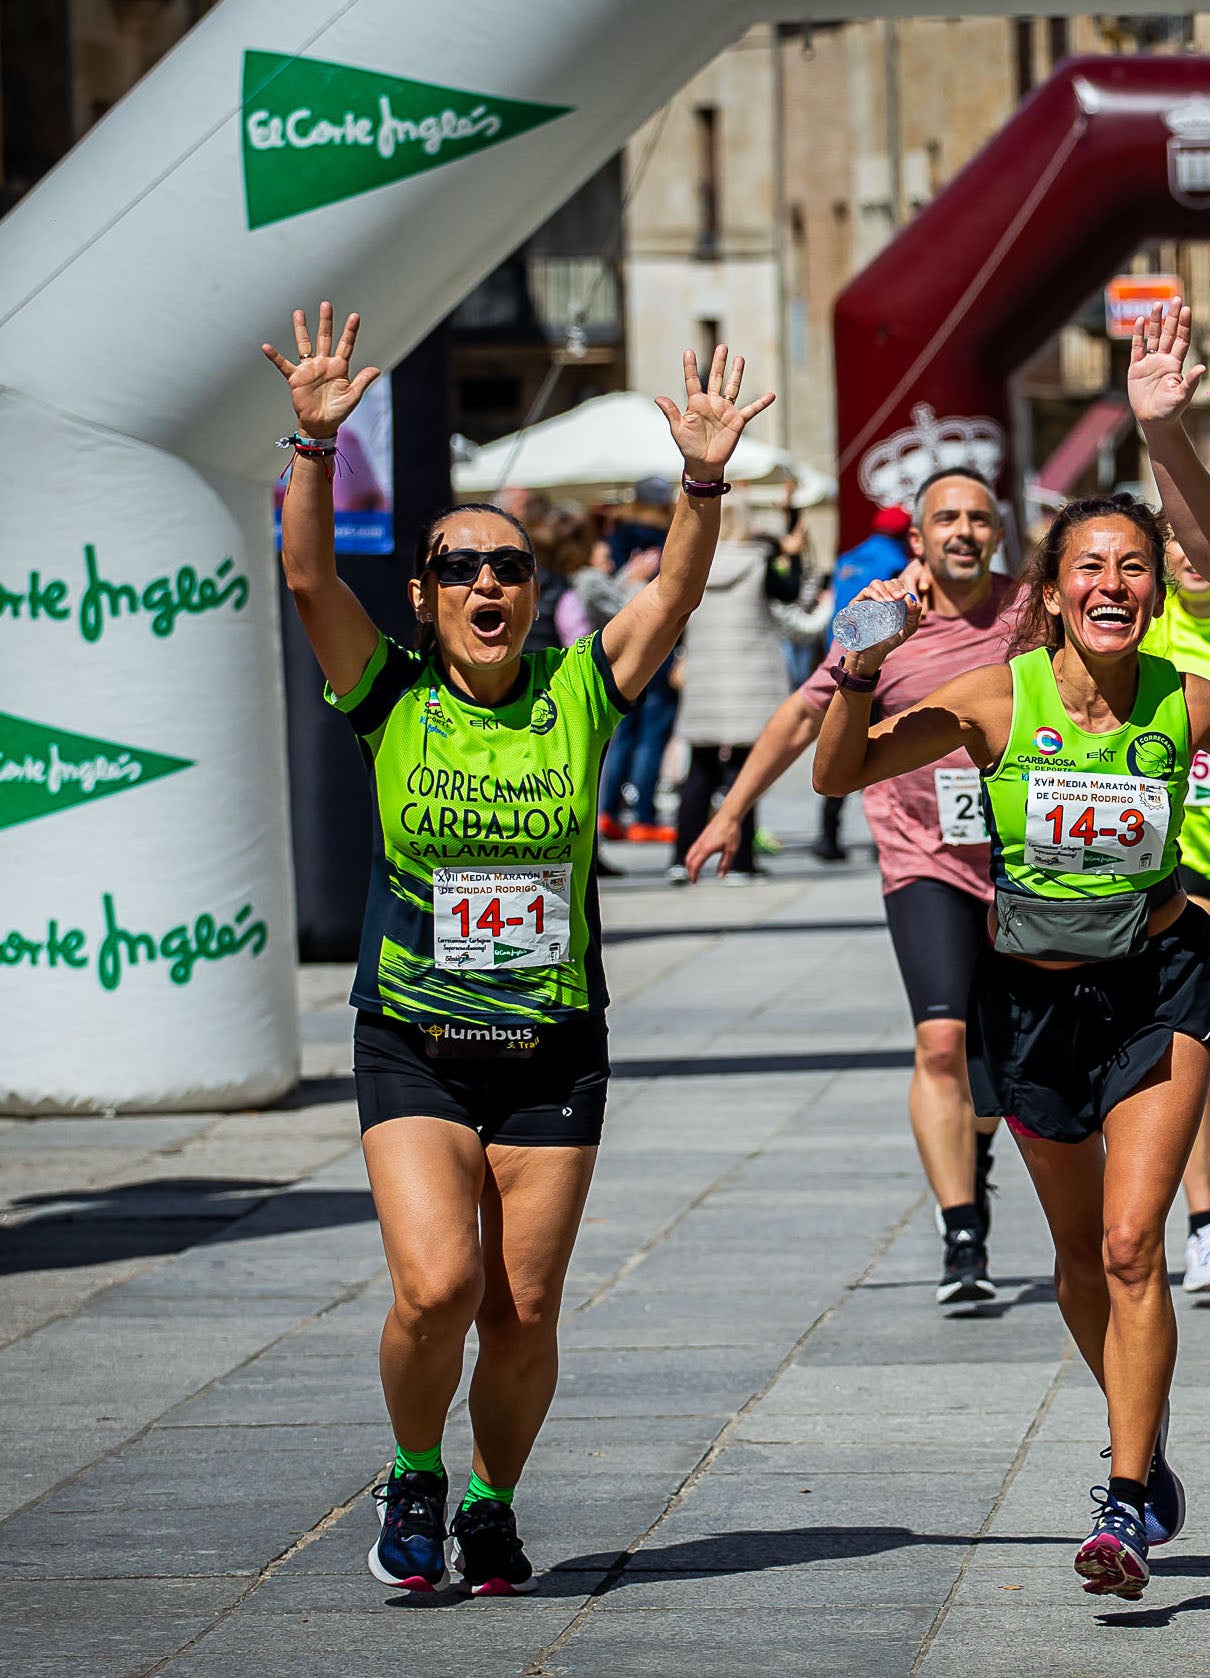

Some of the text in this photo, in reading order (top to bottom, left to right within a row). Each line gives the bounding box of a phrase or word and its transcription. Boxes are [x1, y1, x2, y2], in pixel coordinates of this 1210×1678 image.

[247, 94, 501, 158] El Corte Inglés
[79, 543, 248, 643] Inglés
[48, 742, 142, 794] Inglés
[1017, 755, 1076, 767] CARBAJOSA
[407, 762, 575, 804] CORRECAMINOS
[1036, 792, 1049, 800] DE
[1051, 791, 1088, 802] CIUDAD
[1090, 793, 1134, 804] RODRIGO
[1057, 779, 1088, 789] MEDIA
[1090, 780, 1137, 791] MARATÓN
[400, 801, 581, 841] CARBAJOSA
[1045, 804, 1146, 848] 14-3
[408, 840, 573, 861] SALAMANCA
[441, 887, 454, 895] DE
[456, 886, 494, 895] CIUDAD
[495, 884, 538, 894] RODRIGO
[461, 873, 492, 882] MEDIA
[494, 870, 540, 881] MARATÓN
[451, 894, 544, 938] 14-1
[97, 893, 268, 990] Inglés
